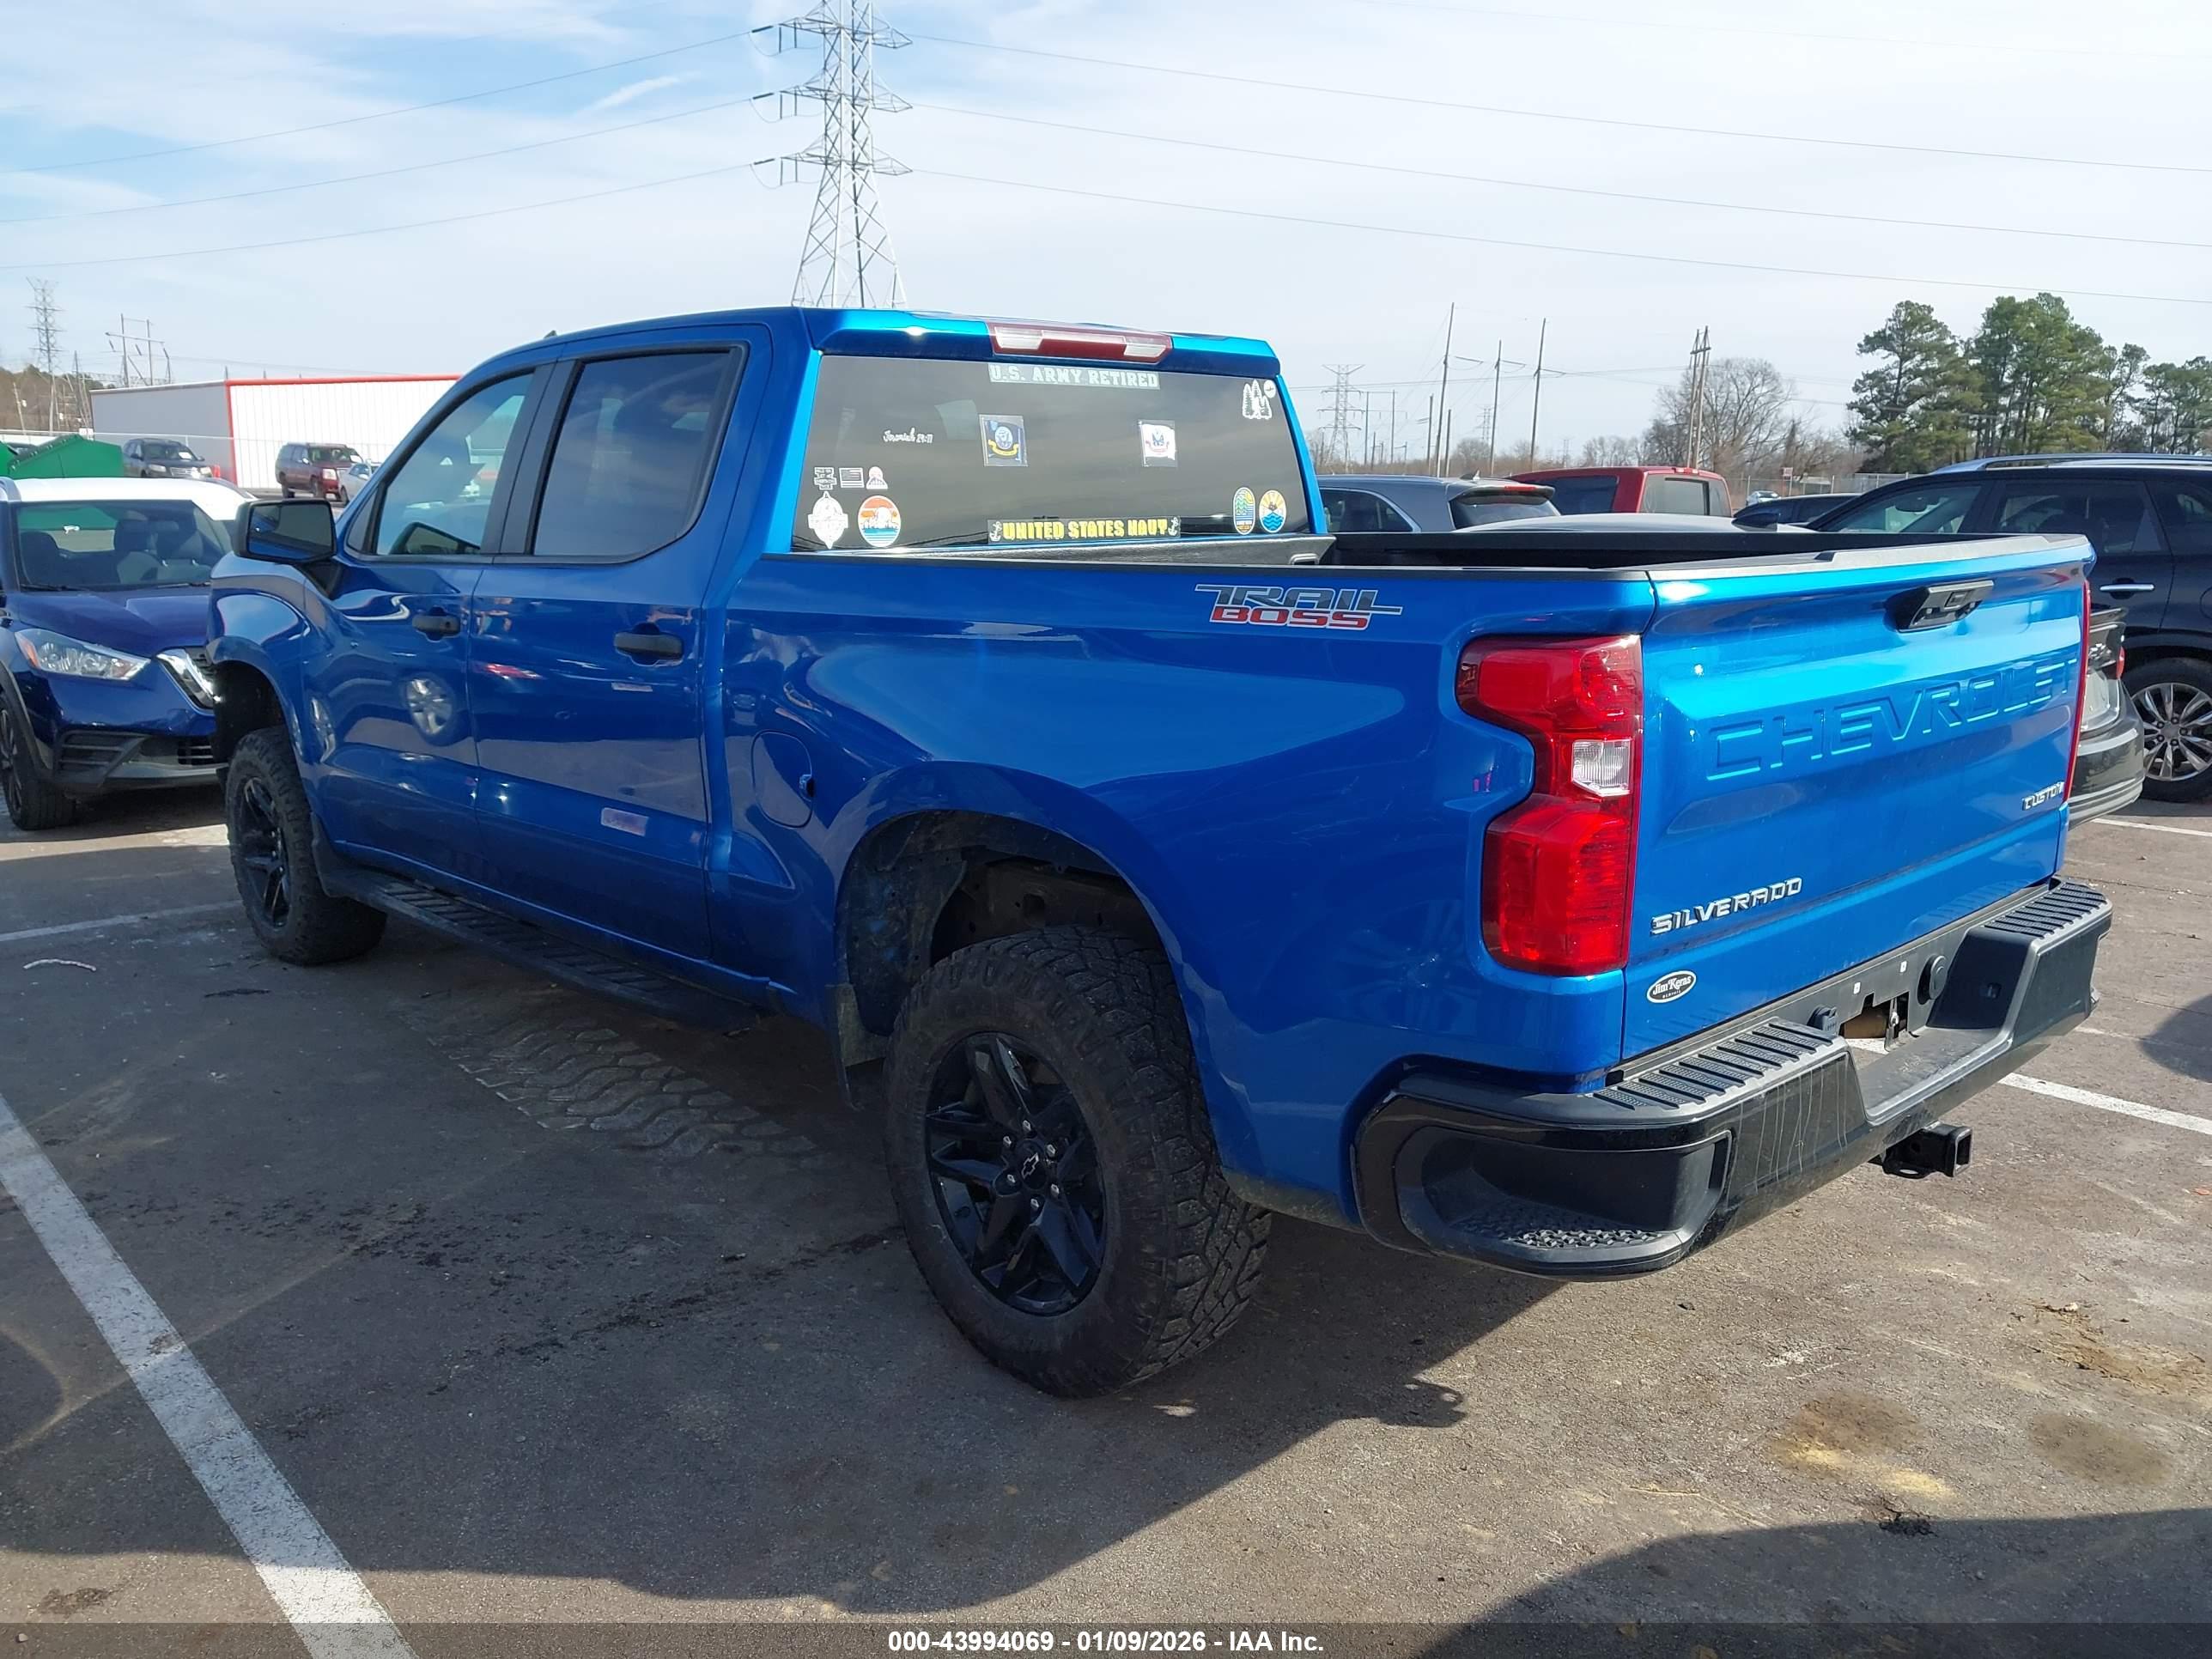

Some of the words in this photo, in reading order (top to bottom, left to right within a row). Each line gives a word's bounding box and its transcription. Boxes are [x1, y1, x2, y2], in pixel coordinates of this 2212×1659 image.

[990, 365, 1025, 381] U.S.
[1032, 367, 1081, 384] ARMY
[1087, 369, 1158, 387] RETIRED
[1002, 520, 1065, 540] UNITED
[1067, 520, 1125, 538] STATES
[1127, 518, 1168, 537] NAVY
[1194, 584, 1403, 615] TRAIL
[1209, 605, 1374, 631] BOSS
[1705, 655, 2078, 781] CHEVROLET
[2022, 781, 2065, 811] CUSTOM
[1650, 877, 1802, 935] SILVERADO
[1652, 982, 1668, 995] Jim
[1668, 975, 1692, 990] Keras
